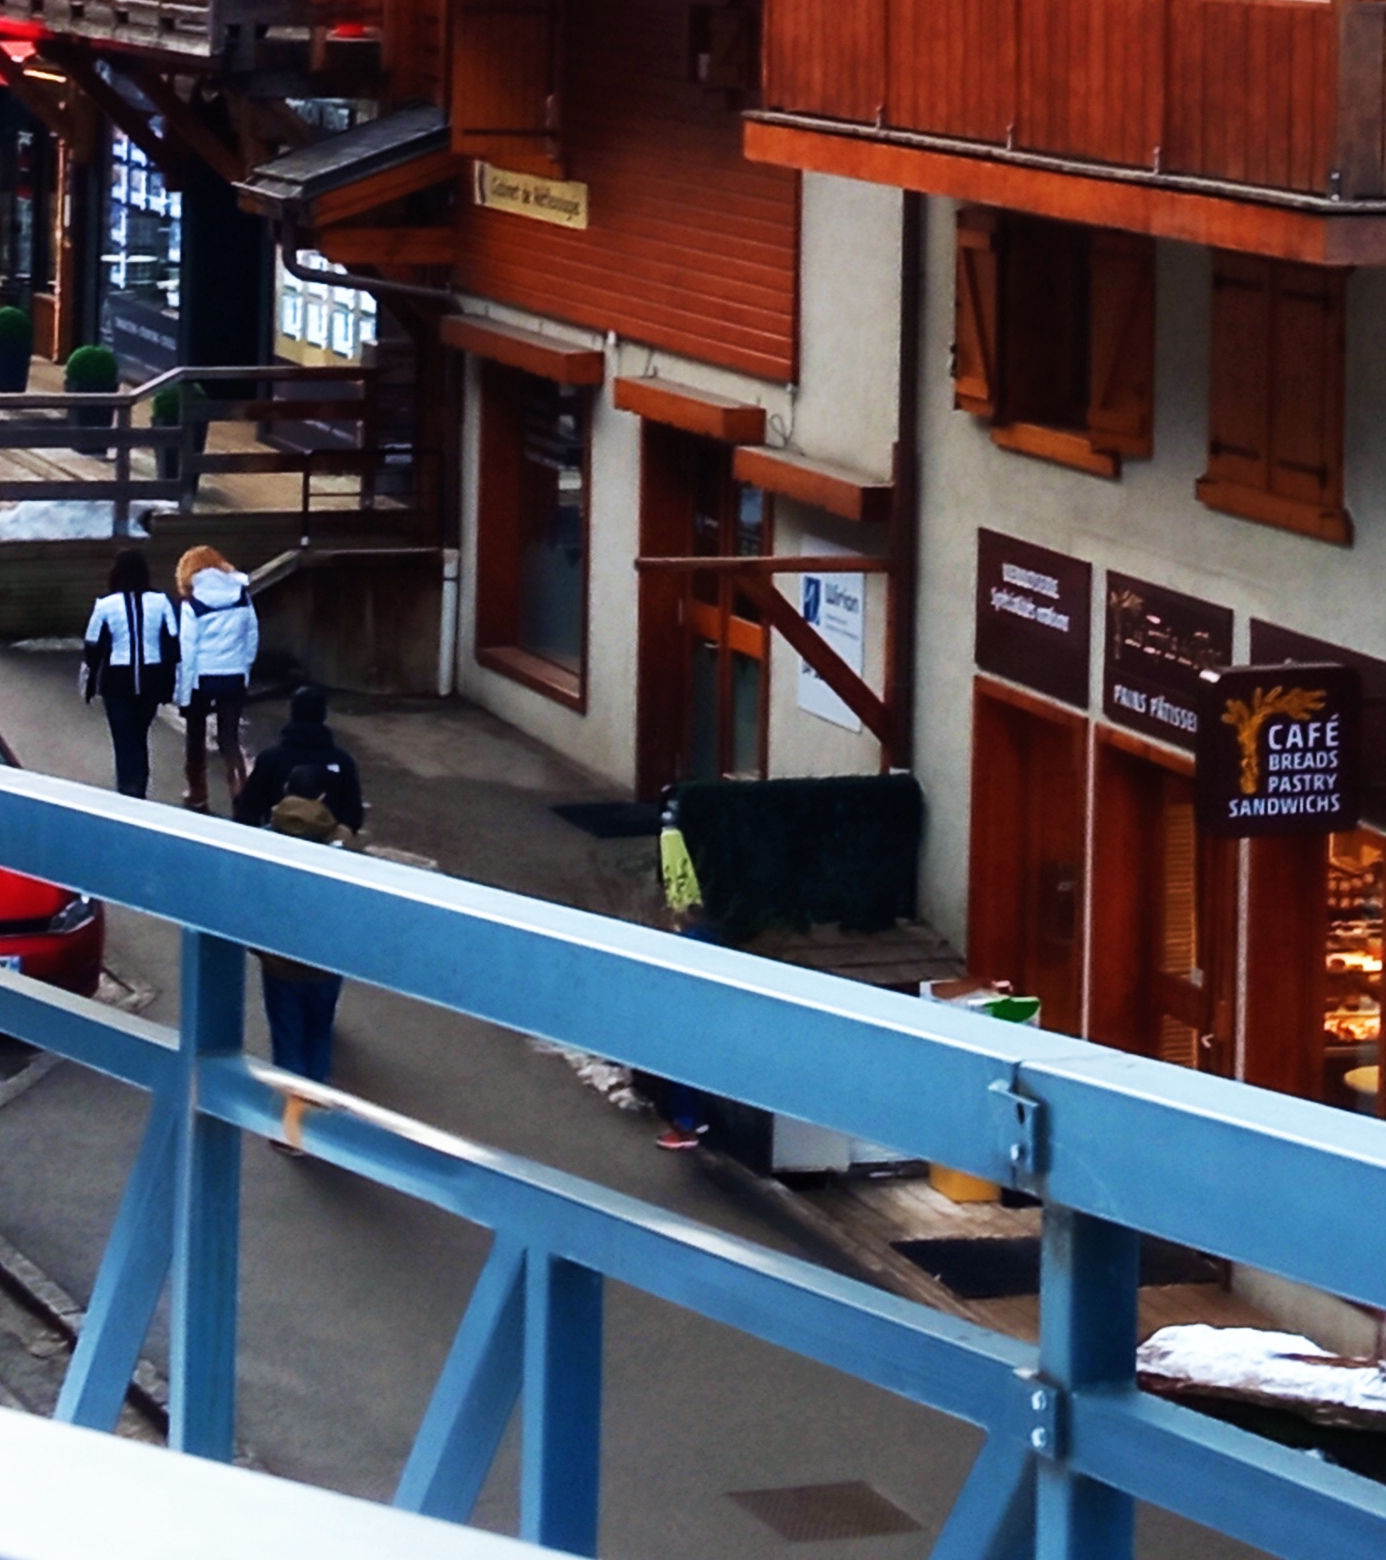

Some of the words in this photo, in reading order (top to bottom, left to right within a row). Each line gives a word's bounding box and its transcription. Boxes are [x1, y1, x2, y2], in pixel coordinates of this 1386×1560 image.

[1114, 684, 1147, 714] PAINS
[1268, 713, 1340, 751] CAFÉ
[1268, 750, 1339, 771] BREADS
[1268, 773, 1337, 793] PASTRY
[1228, 793, 1341, 818] SANDWICHS
